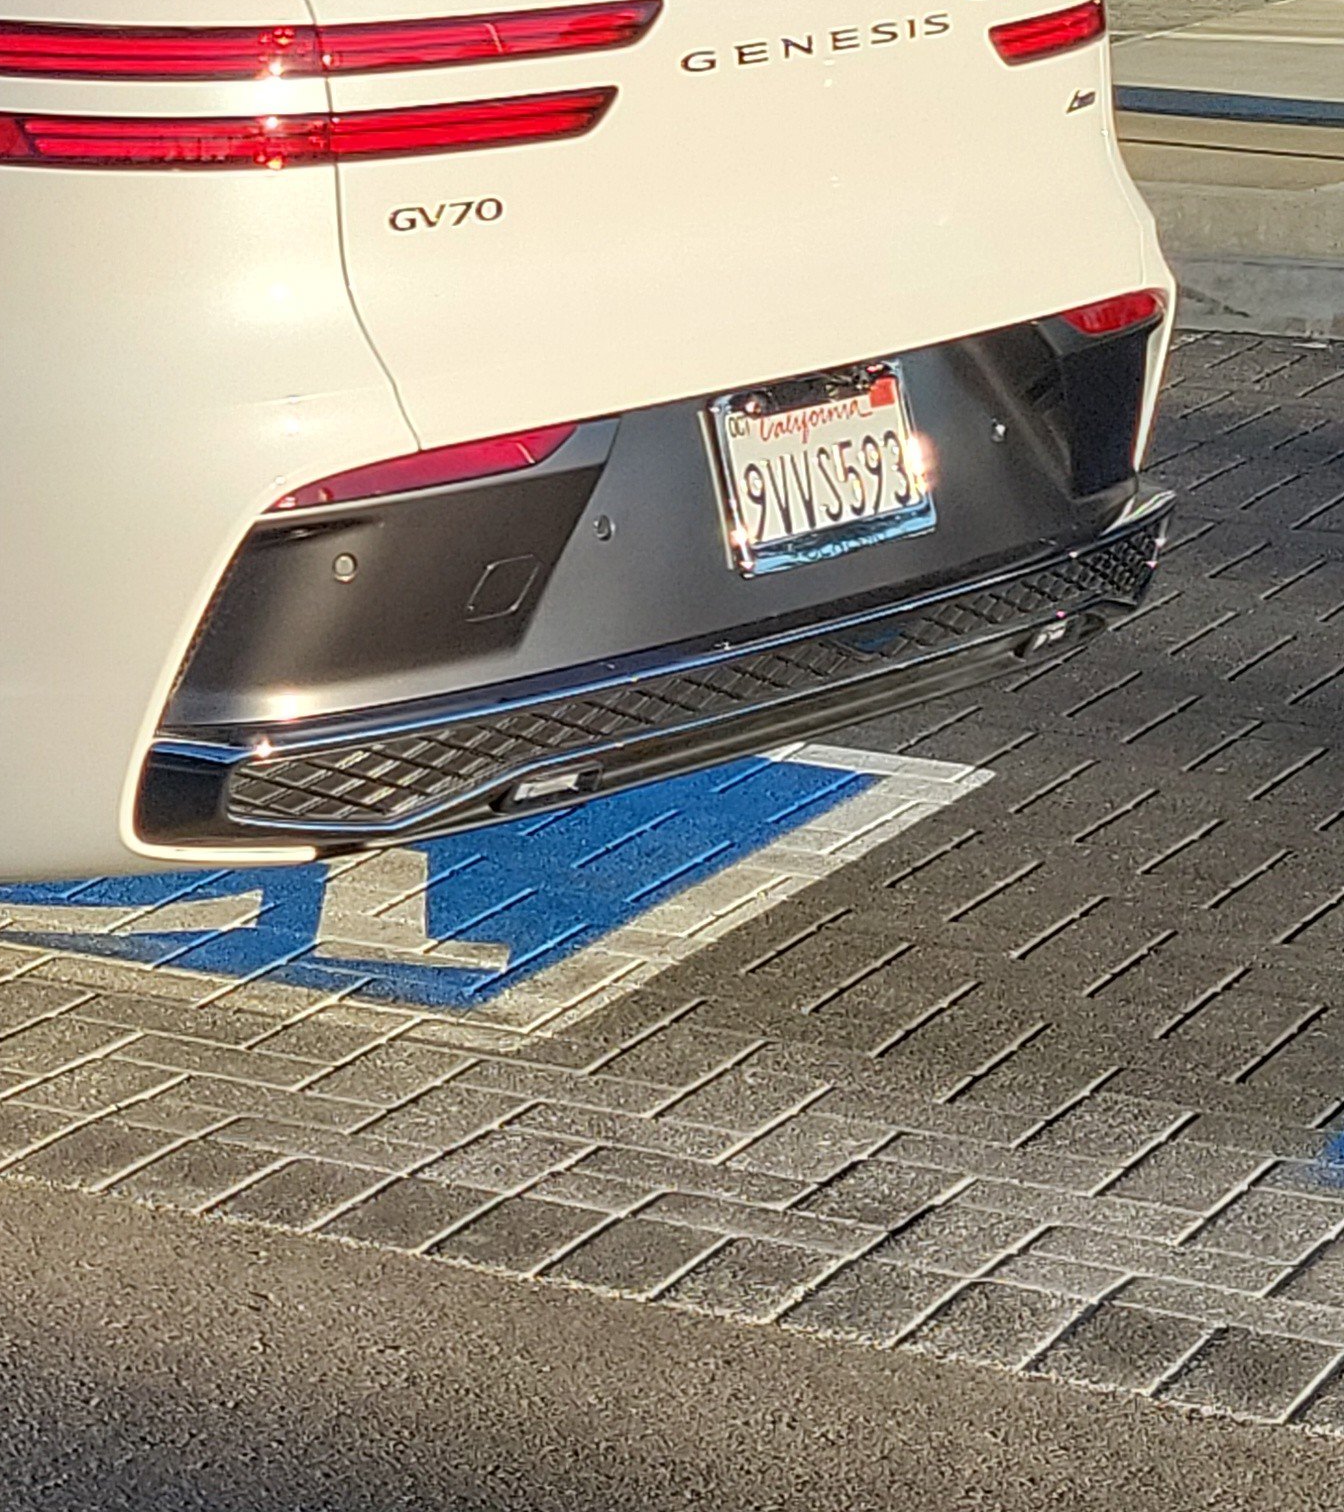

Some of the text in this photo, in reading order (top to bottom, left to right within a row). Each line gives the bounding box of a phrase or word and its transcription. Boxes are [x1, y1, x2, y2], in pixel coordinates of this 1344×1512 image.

[680, 13, 950, 72] GENESIS
[388, 197, 504, 232] GV70
[759, 399, 872, 444] California
[743, 430, 911, 544] 9VVS593
